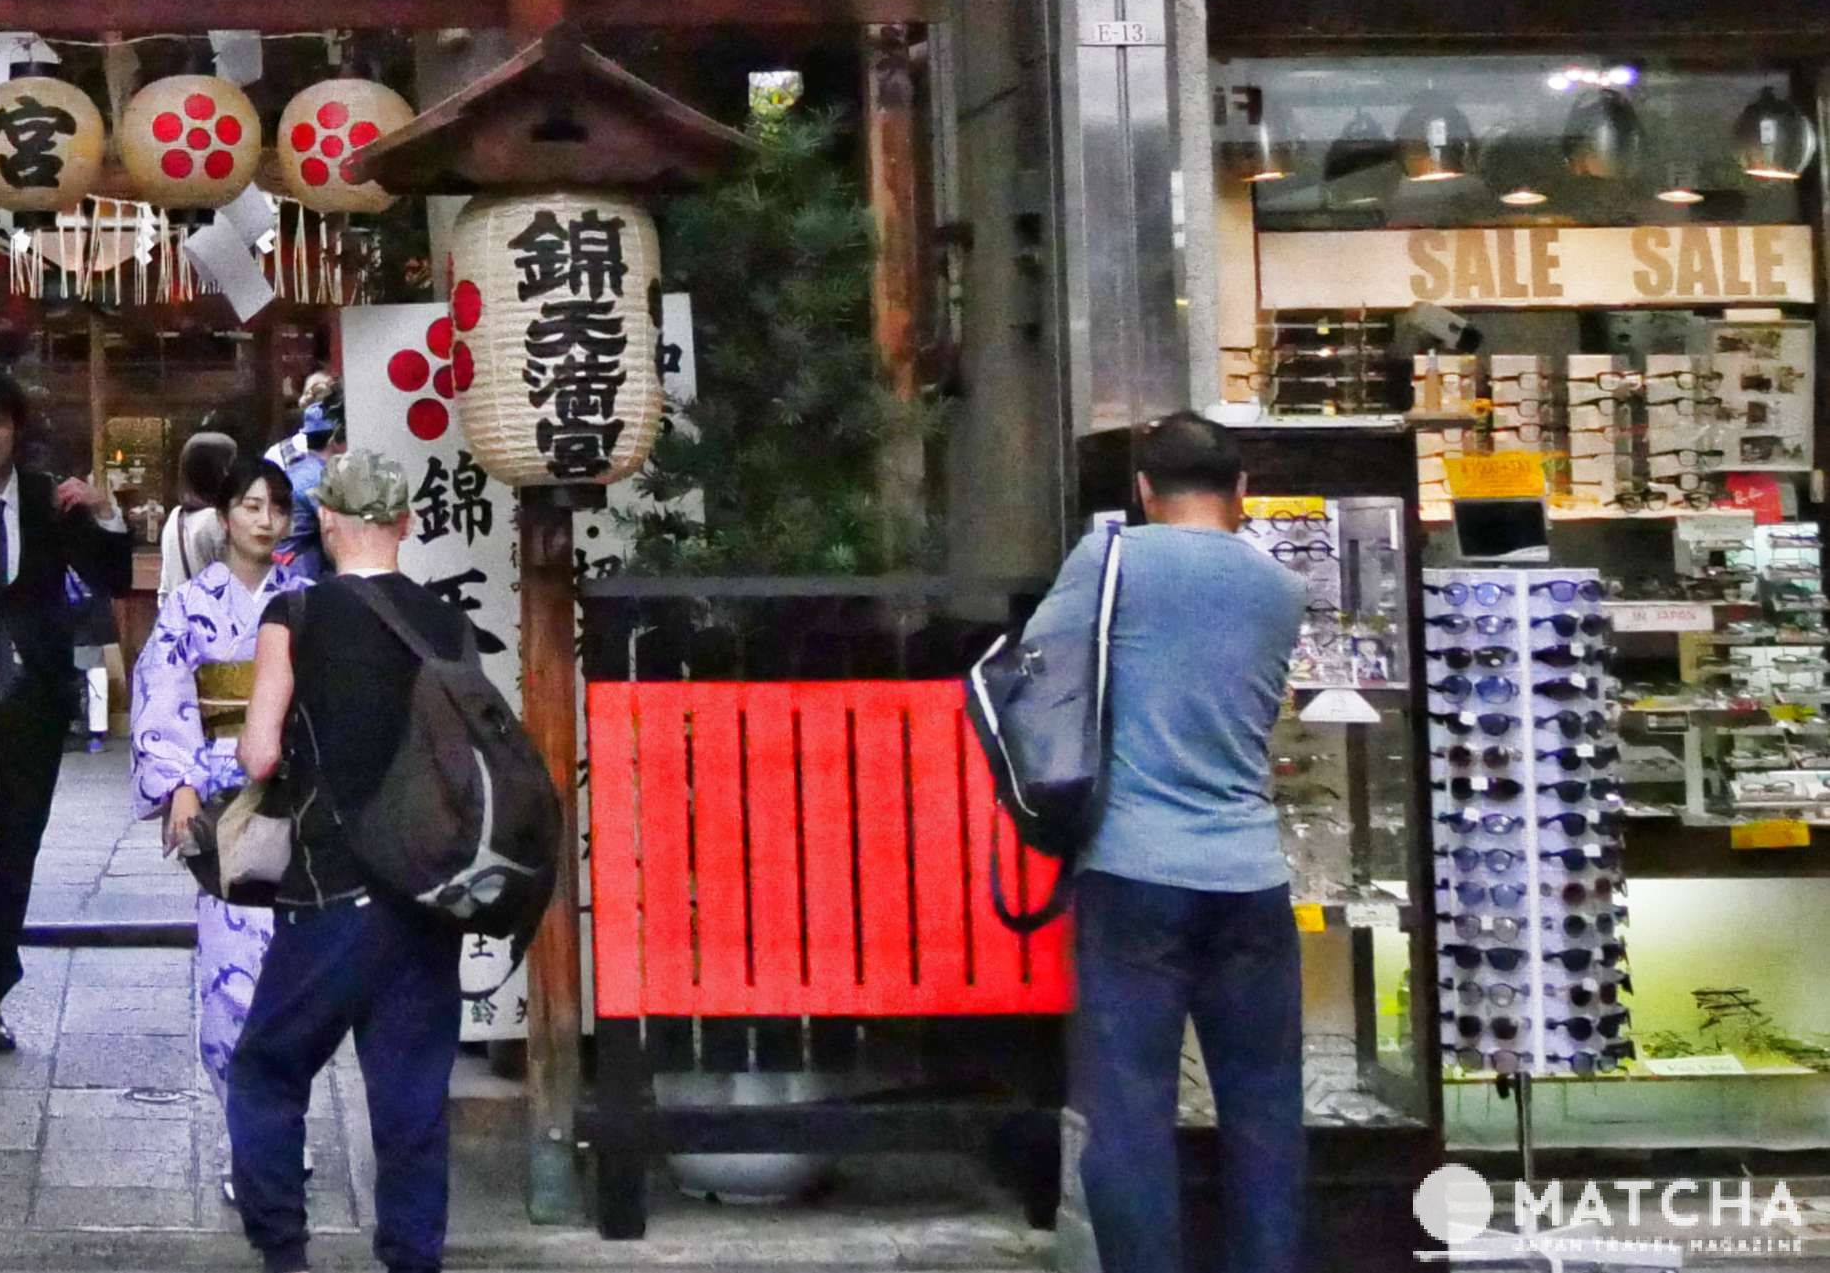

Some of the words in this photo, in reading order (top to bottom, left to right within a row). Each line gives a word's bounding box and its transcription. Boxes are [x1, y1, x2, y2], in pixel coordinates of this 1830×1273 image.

[1098, 24, 1144, 43] E-13
[1407, 227, 1564, 301] SALE
[1631, 226, 1788, 297] SALE
[507, 209, 630, 479] 錦天満宮
